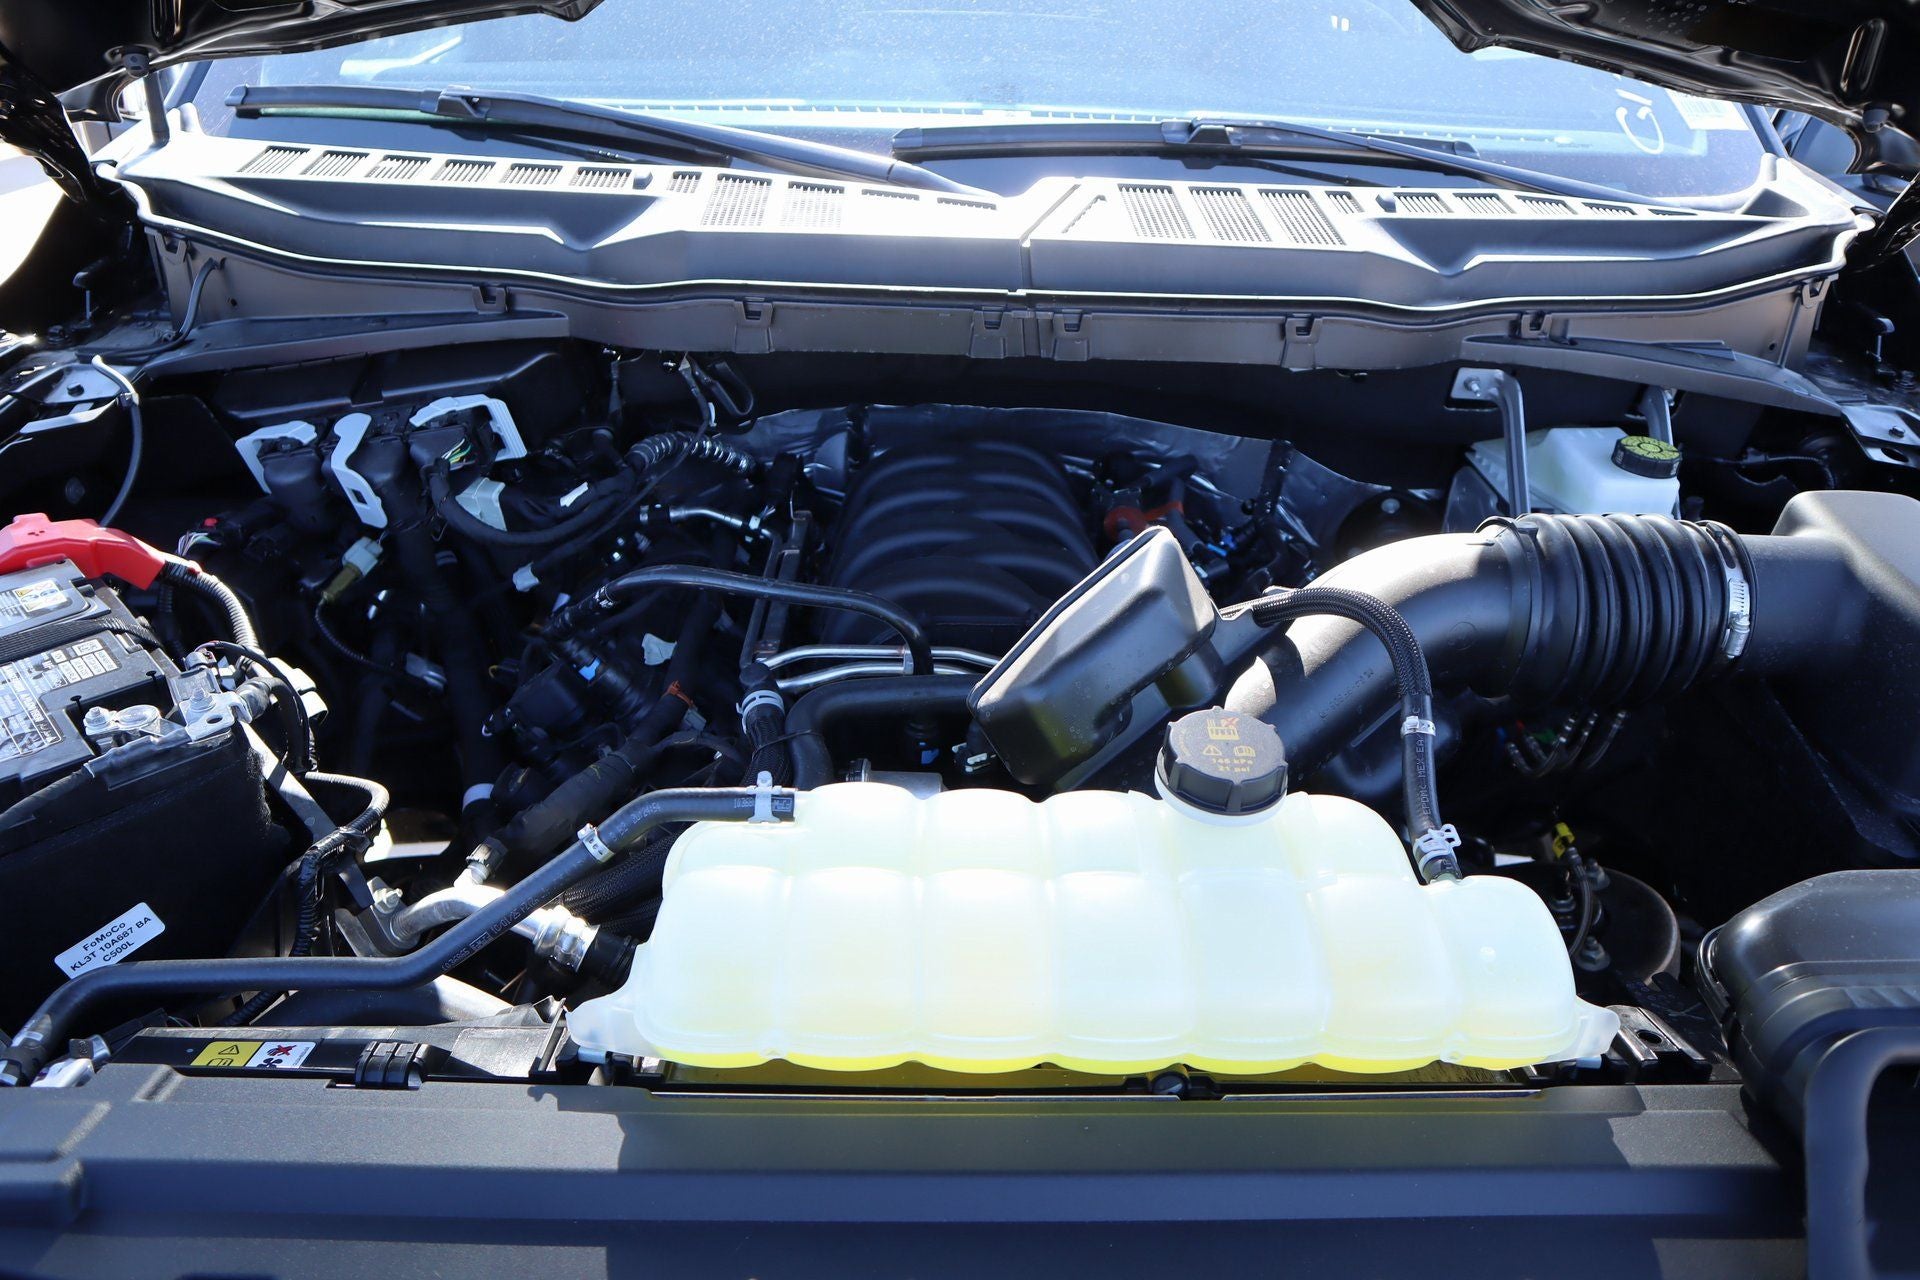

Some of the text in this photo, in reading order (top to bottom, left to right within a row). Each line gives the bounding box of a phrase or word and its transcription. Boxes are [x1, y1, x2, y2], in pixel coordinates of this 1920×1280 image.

[70, 916, 152, 972] KL3T 10A687 BA
[83, 922, 126, 952] FoMoCo
[103, 940, 134, 962] C500L
